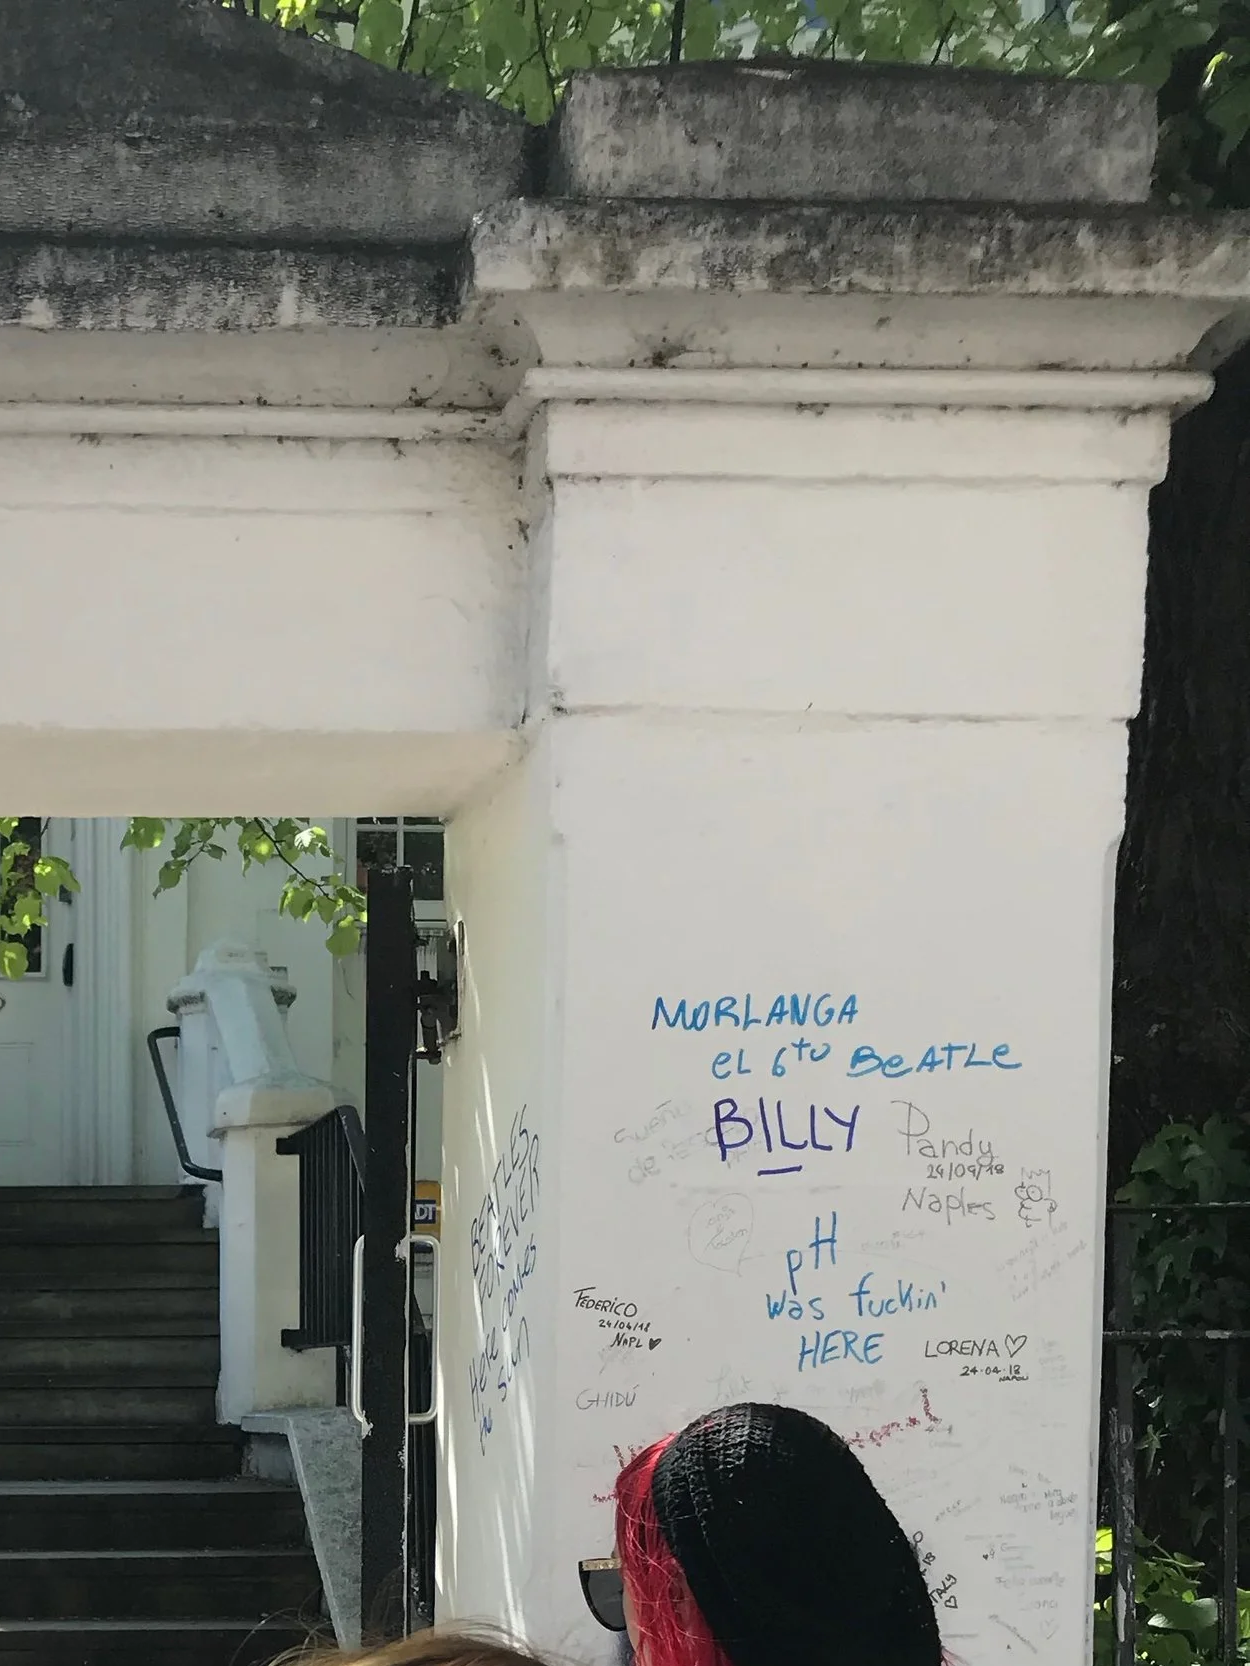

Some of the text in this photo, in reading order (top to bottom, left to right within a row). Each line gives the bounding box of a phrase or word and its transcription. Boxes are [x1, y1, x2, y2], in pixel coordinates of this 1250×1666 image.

[651, 993, 860, 1032] MORLANGA
[713, 1097, 860, 1163] BILLY
[797, 1330, 886, 1373] HERE
[924, 1338, 1001, 1358] LORENA
